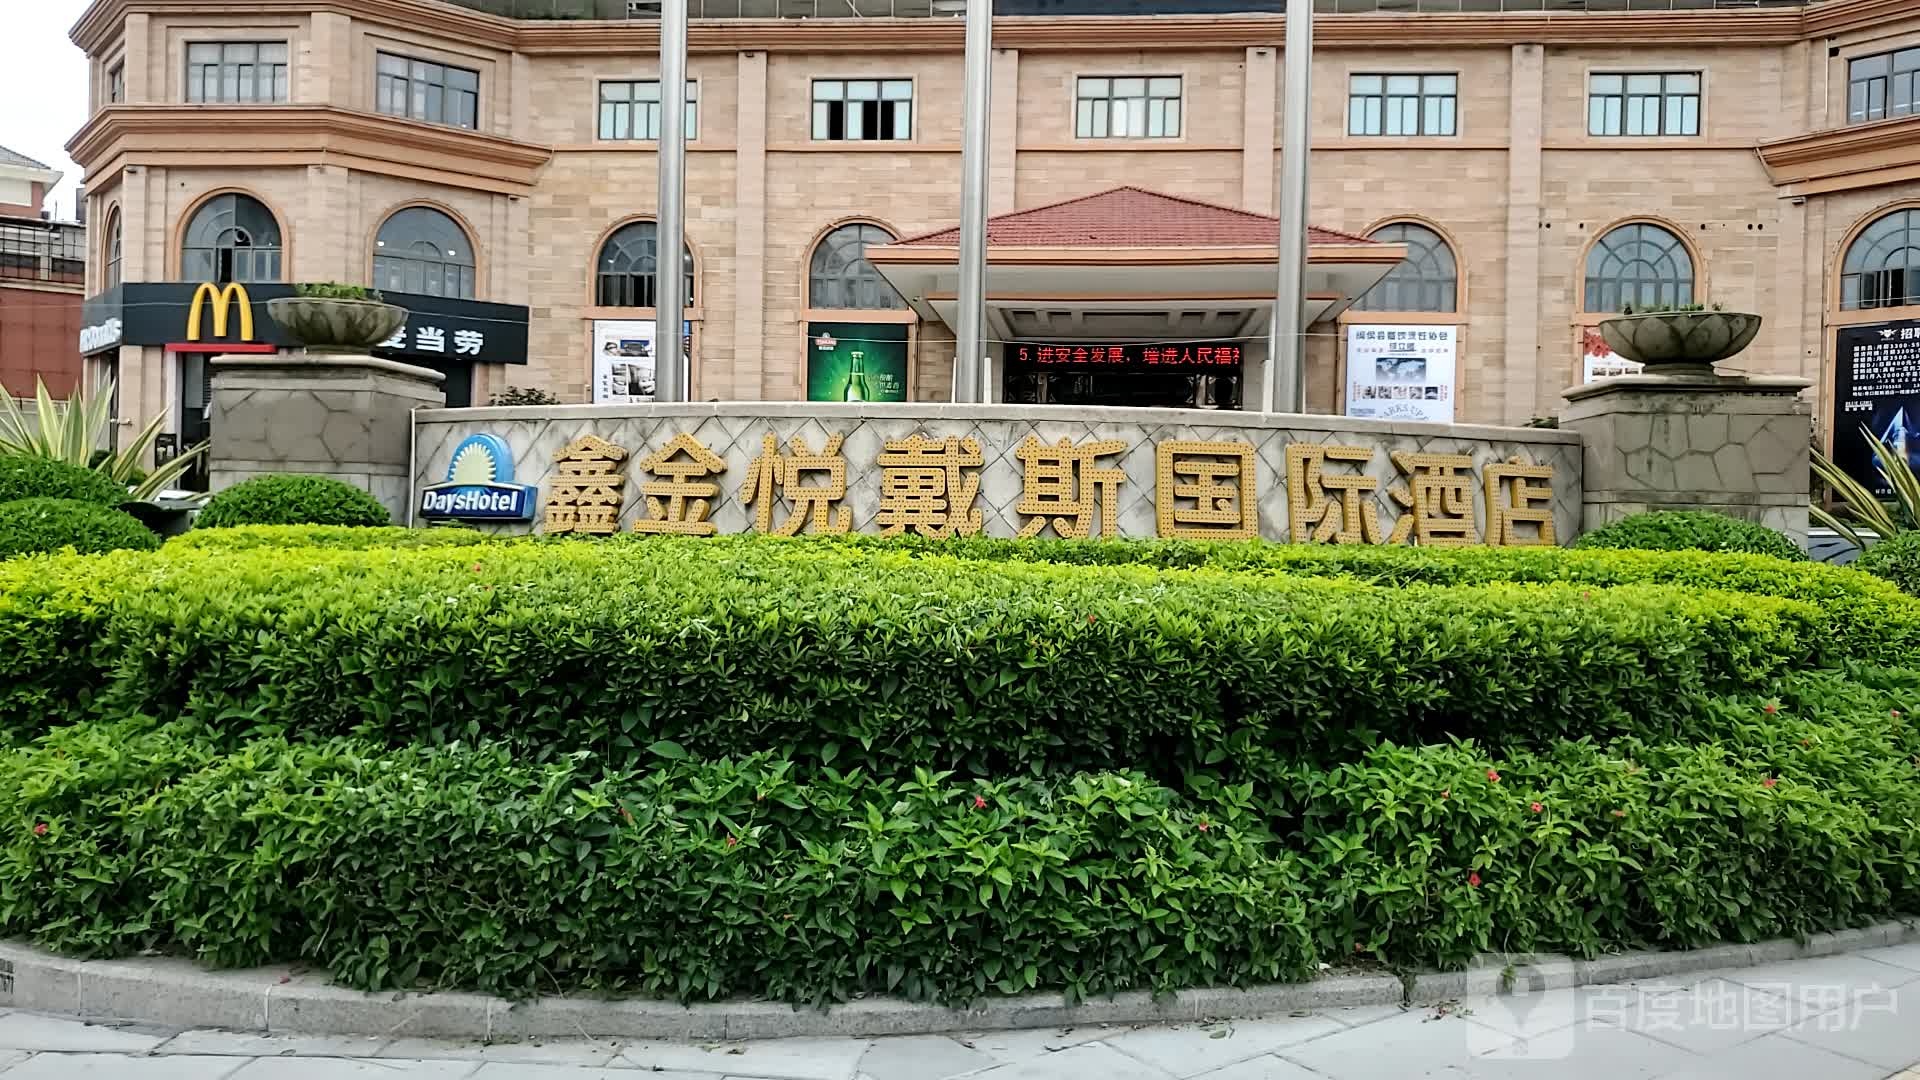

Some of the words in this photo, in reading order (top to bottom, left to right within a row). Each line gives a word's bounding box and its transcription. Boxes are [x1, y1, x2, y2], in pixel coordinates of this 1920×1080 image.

[544, 431, 1555, 546] 鑫金悦戴斯国际酒店
